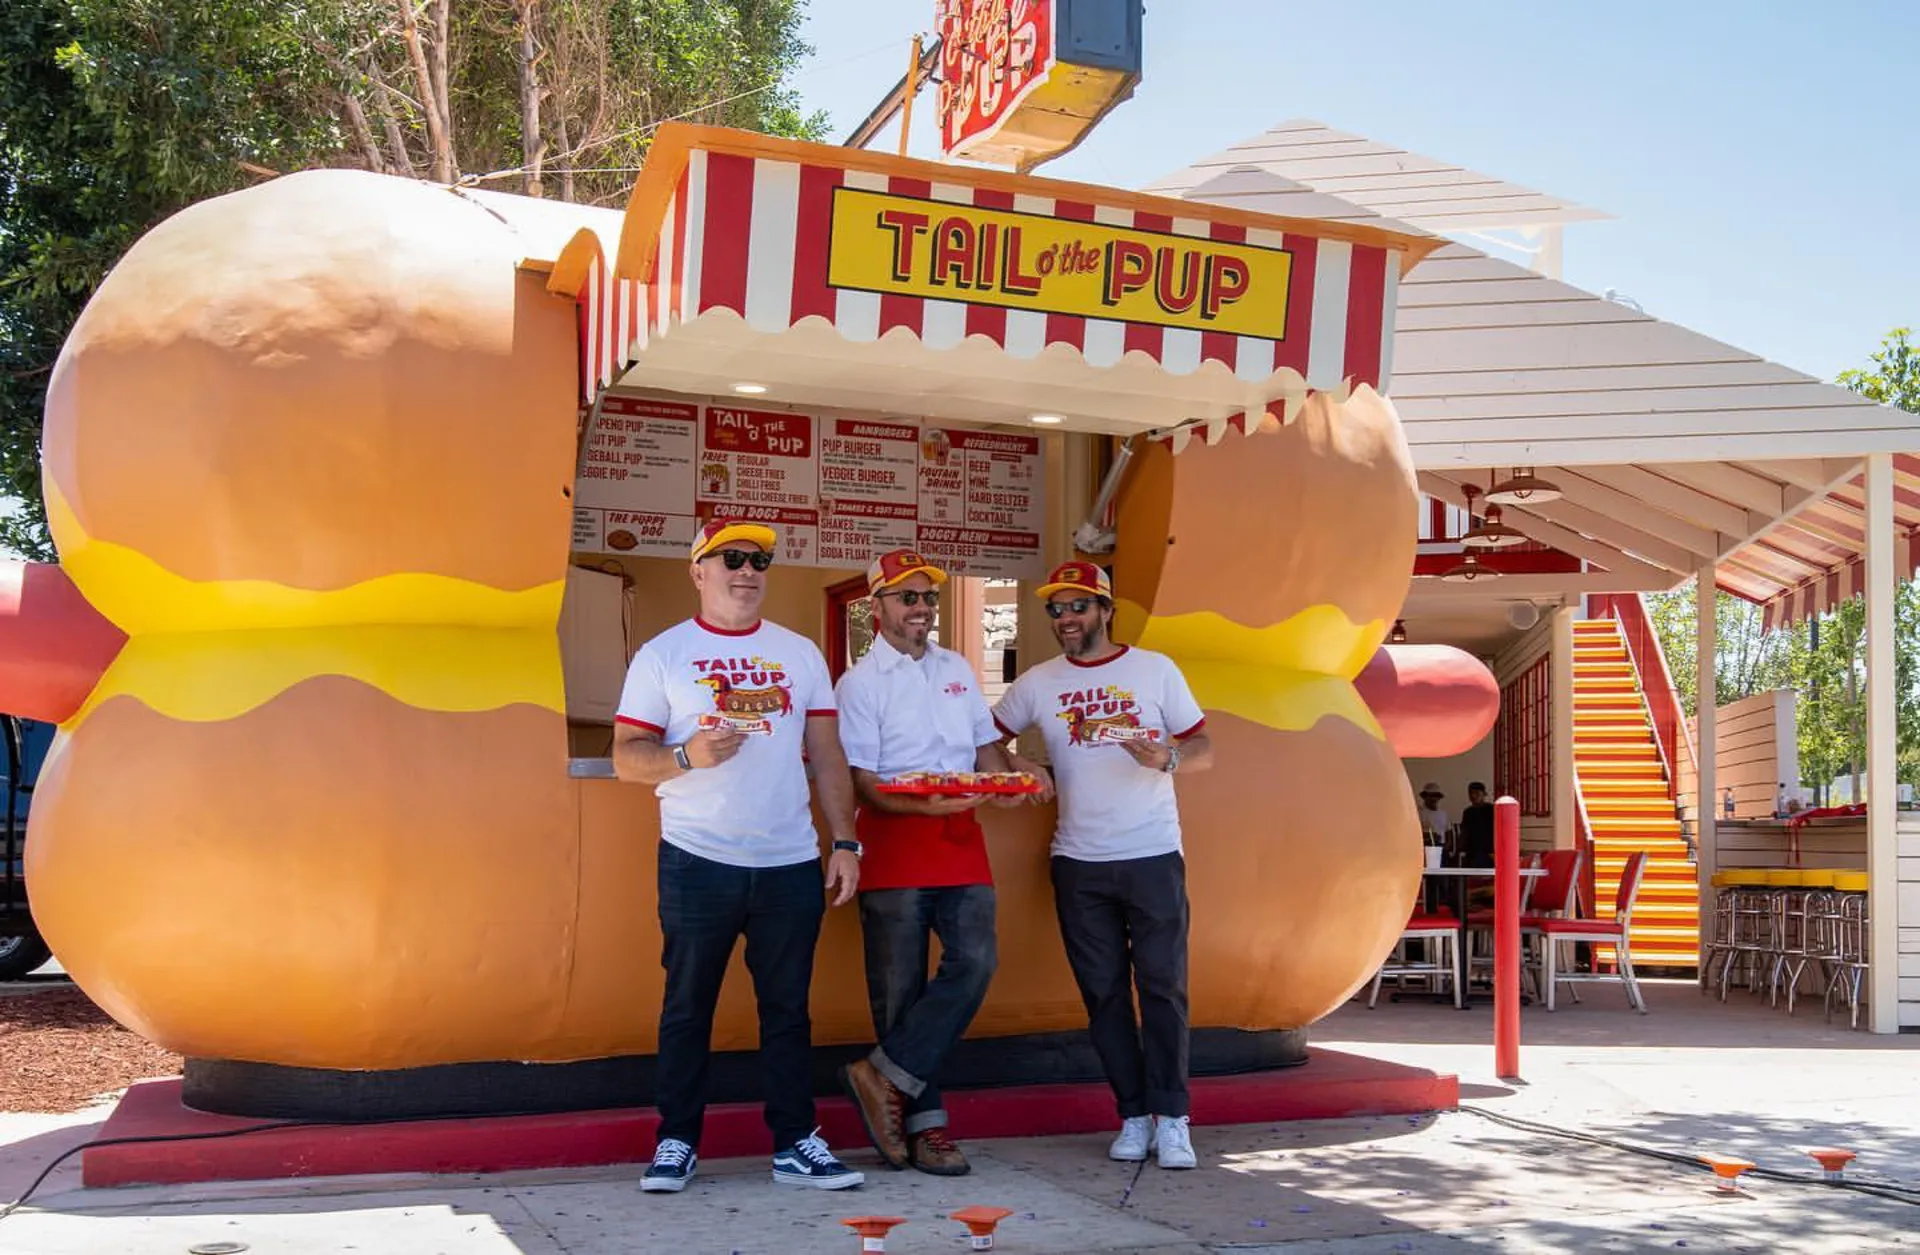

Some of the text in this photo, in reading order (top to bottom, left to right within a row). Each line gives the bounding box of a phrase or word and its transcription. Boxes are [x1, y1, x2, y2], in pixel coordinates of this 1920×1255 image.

[877, 210, 1042, 296] TAIL
[1102, 239, 1250, 320] PUP
[625, 420, 644, 433] PUP
[713, 409, 754, 429] TAIL
[763, 420, 786, 434] THE
[608, 435, 627, 448] PUP
[767, 436, 805, 454] PUP
[822, 438, 882, 455] PUP BURGER
[623, 452, 643, 465] PUP
[702, 451, 728, 462] FRIES
[736, 467, 785, 480] CHEESE FRIES
[968, 460, 991, 473] BEER
[609, 468, 629, 481] PUP
[822, 465, 896, 484] VEGGIE BURGER
[736, 478, 780, 491] CHILLI FRIES
[926, 478, 962, 490] DRINKS
[968, 476, 990, 489] WINE
[968, 491, 992, 504] HARD
[993, 493, 1029, 507] SELTZER
[609, 512, 629, 523] THE
[713, 504, 745, 517] CORN
[747, 506, 780, 519] DOGS
[967, 510, 1014, 524] COCKTAILS
[641, 525, 664, 536] DOG
[820, 518, 854, 530] SHAKES
[820, 531, 842, 543] SOFT
[843, 532, 871, 545] SERVE
[920, 527, 958, 540] DOGGY
[958, 530, 991, 543] MENU
[820, 547, 871, 561] SODA FLOAT
[920, 542, 956, 555] BOWSER
[957, 544, 978, 557] BEER
[949, 559, 967, 572] PUP
[692, 658, 755, 672] TAIL
[731, 671, 786, 686] PUP
[1058, 687, 1110, 706] TAIL
[1086, 700, 1135, 716] PUP
